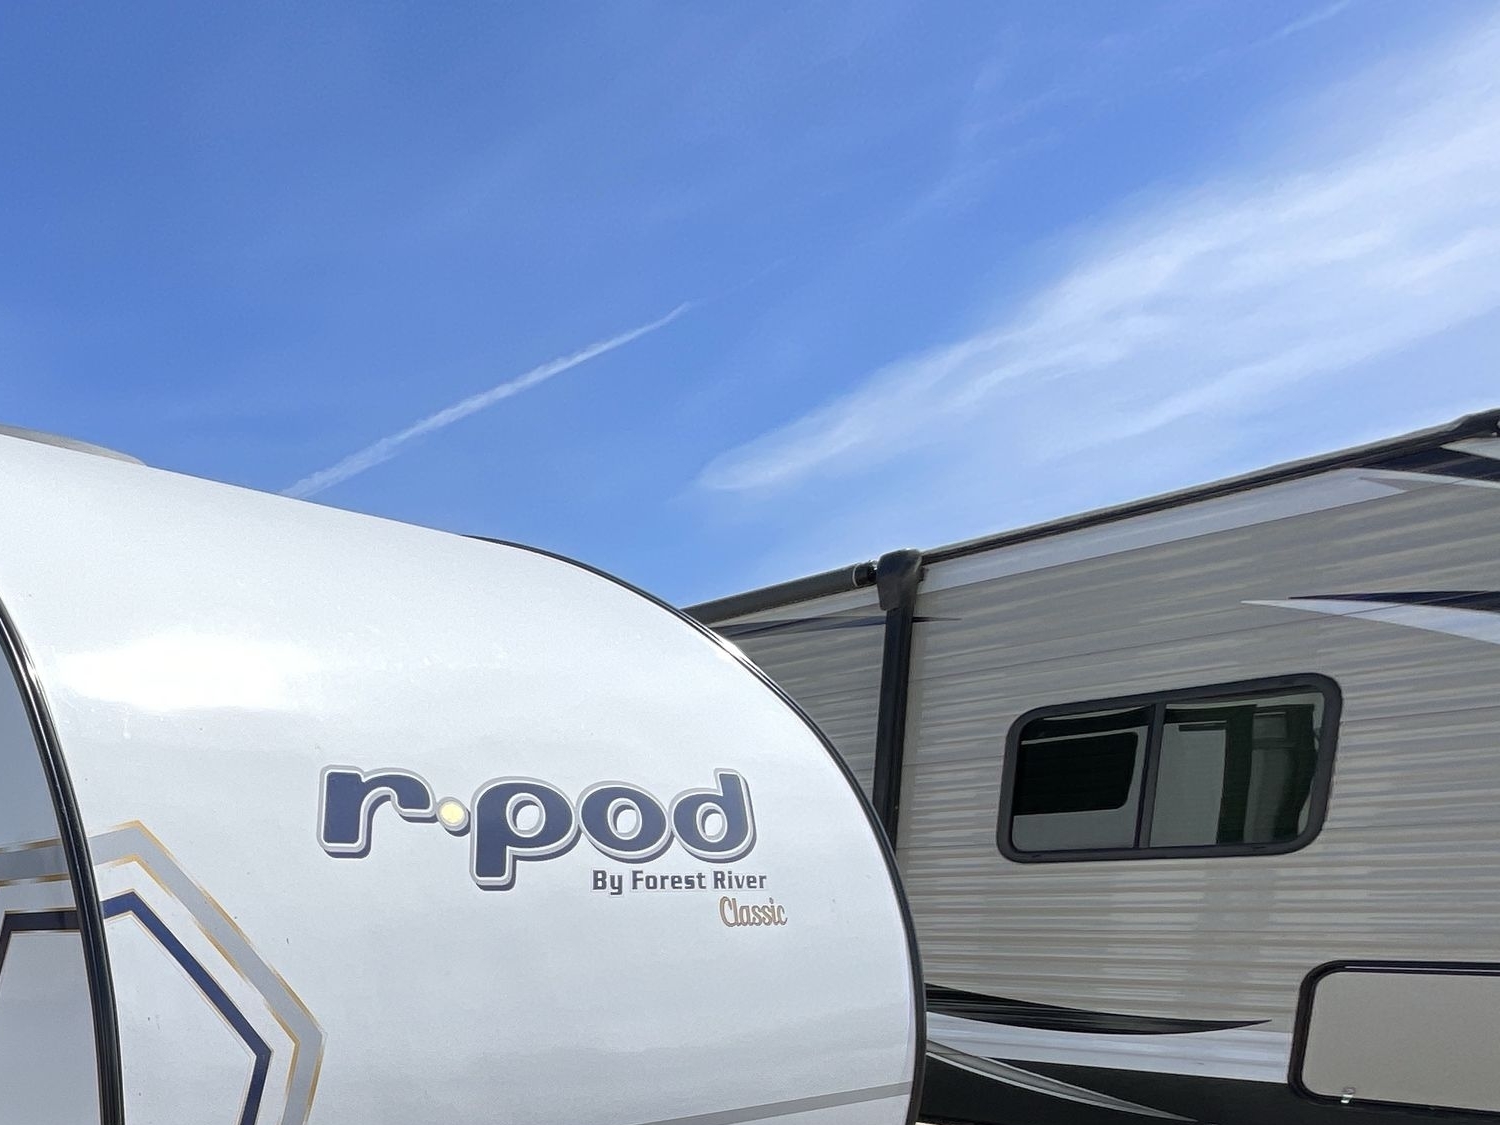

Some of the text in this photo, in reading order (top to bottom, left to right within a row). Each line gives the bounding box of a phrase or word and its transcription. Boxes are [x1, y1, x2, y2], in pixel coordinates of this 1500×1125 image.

[592, 869, 768, 896] By Forest River
[718, 896, 788, 927] Classic
